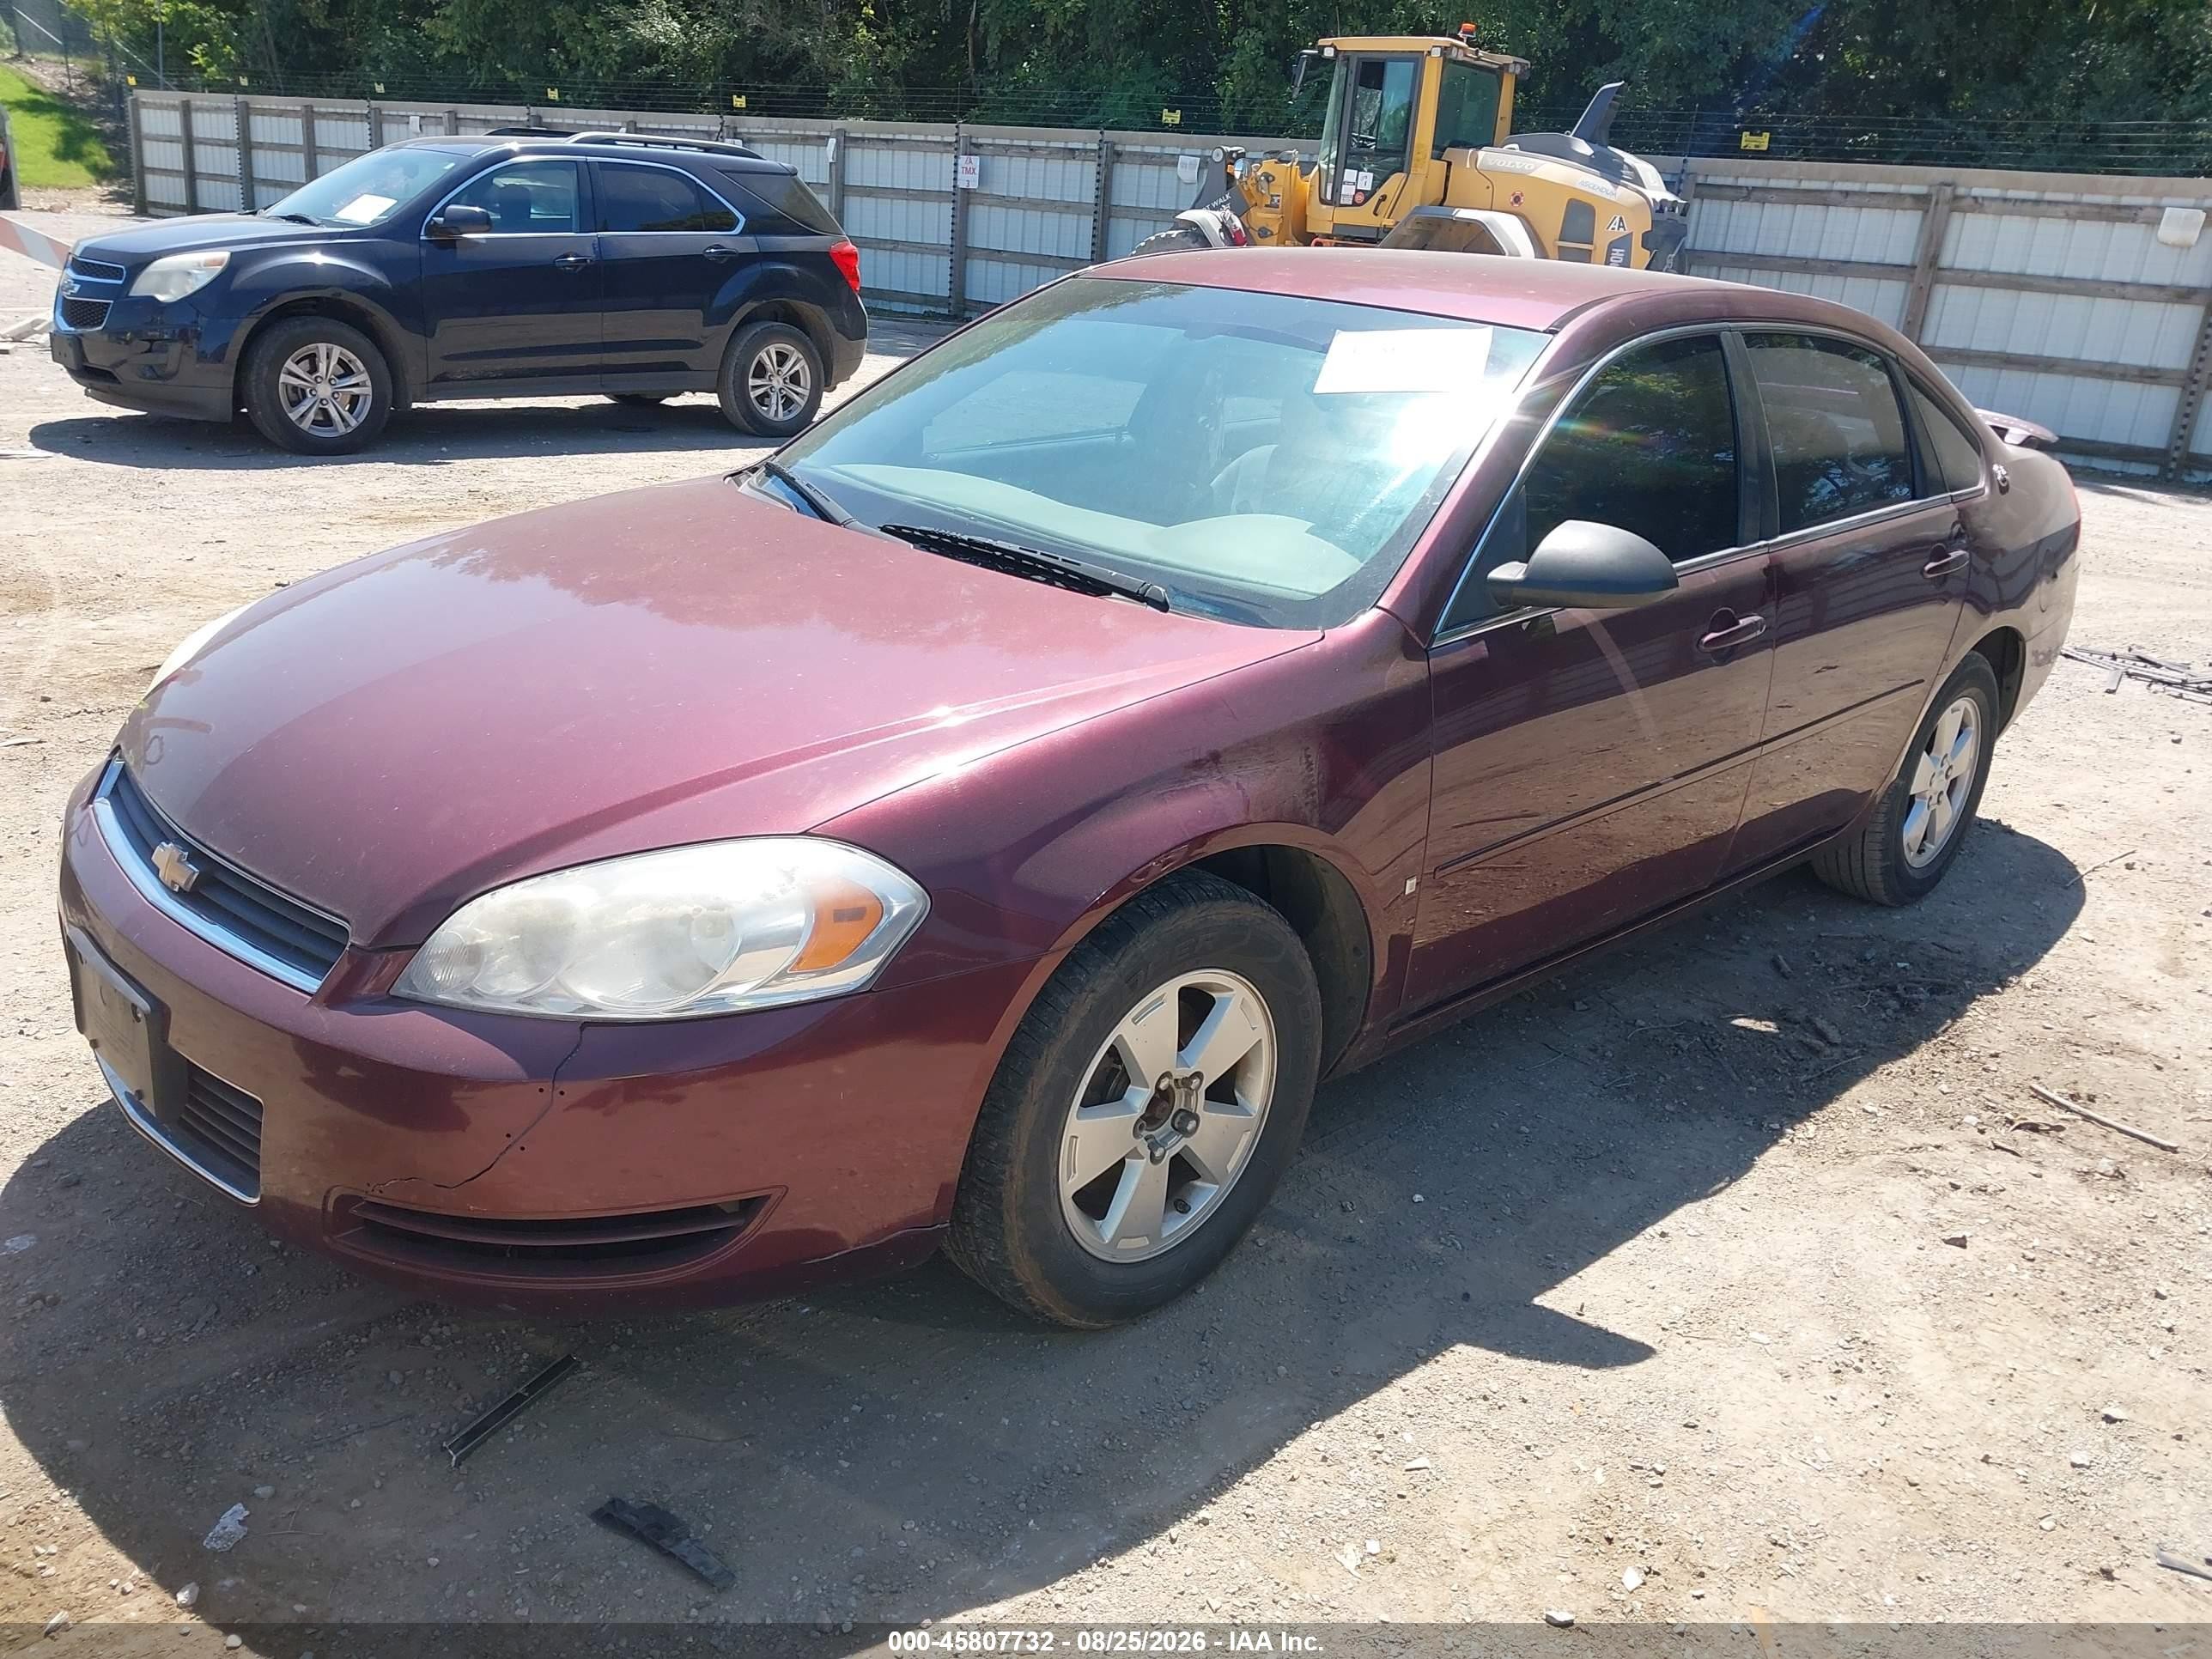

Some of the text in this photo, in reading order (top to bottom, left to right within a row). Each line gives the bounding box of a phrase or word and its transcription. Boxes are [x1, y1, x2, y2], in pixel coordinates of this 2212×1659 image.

[1486, 157, 1535, 170] VOLVO
[962, 167, 976, 175] TMX
[1578, 179, 1617, 198] ASCENDUM
[1211, 192, 1231, 208] WALK
